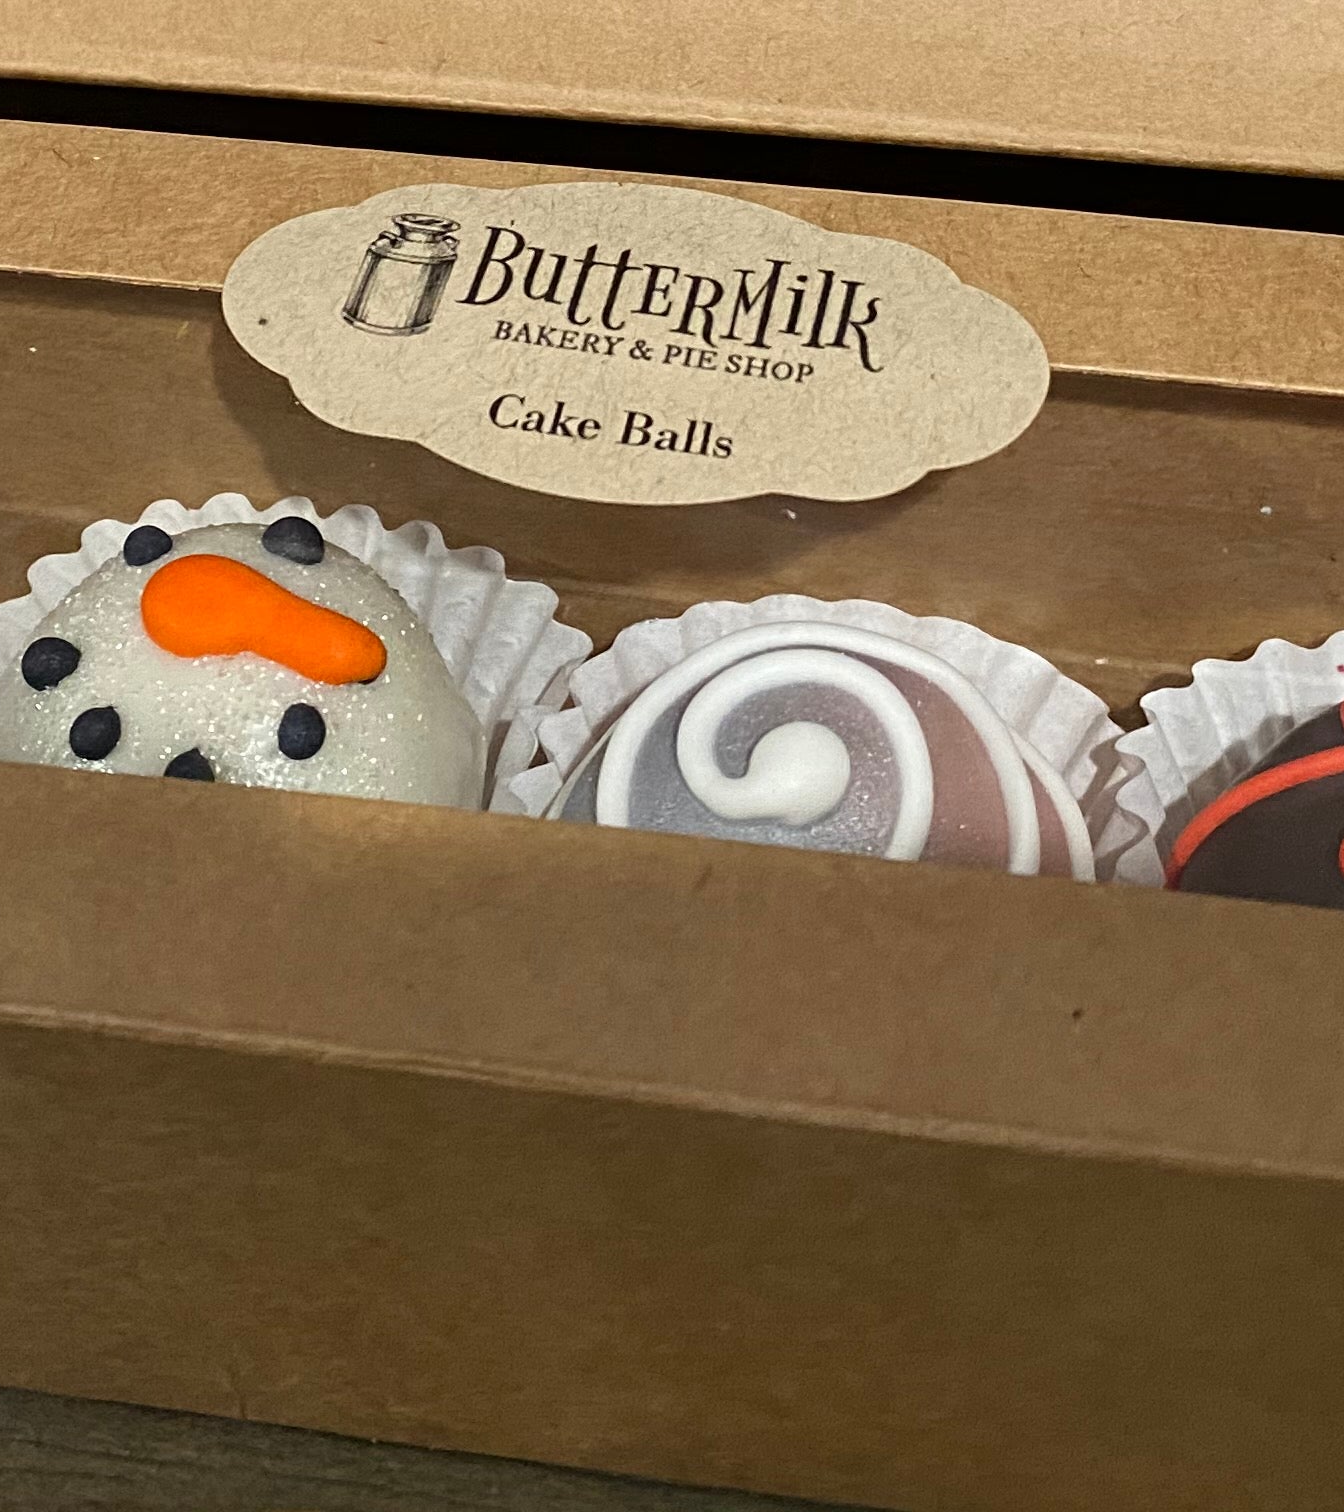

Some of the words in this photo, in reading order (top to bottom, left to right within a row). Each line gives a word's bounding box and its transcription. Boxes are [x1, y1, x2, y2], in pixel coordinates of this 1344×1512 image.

[493, 320, 625, 357] BAKERY
[628, 339, 654, 362] &
[662, 342, 719, 371] PIE
[724, 353, 815, 384] SHOP
[488, 393, 602, 442] Cake
[619, 410, 734, 460] Balls
